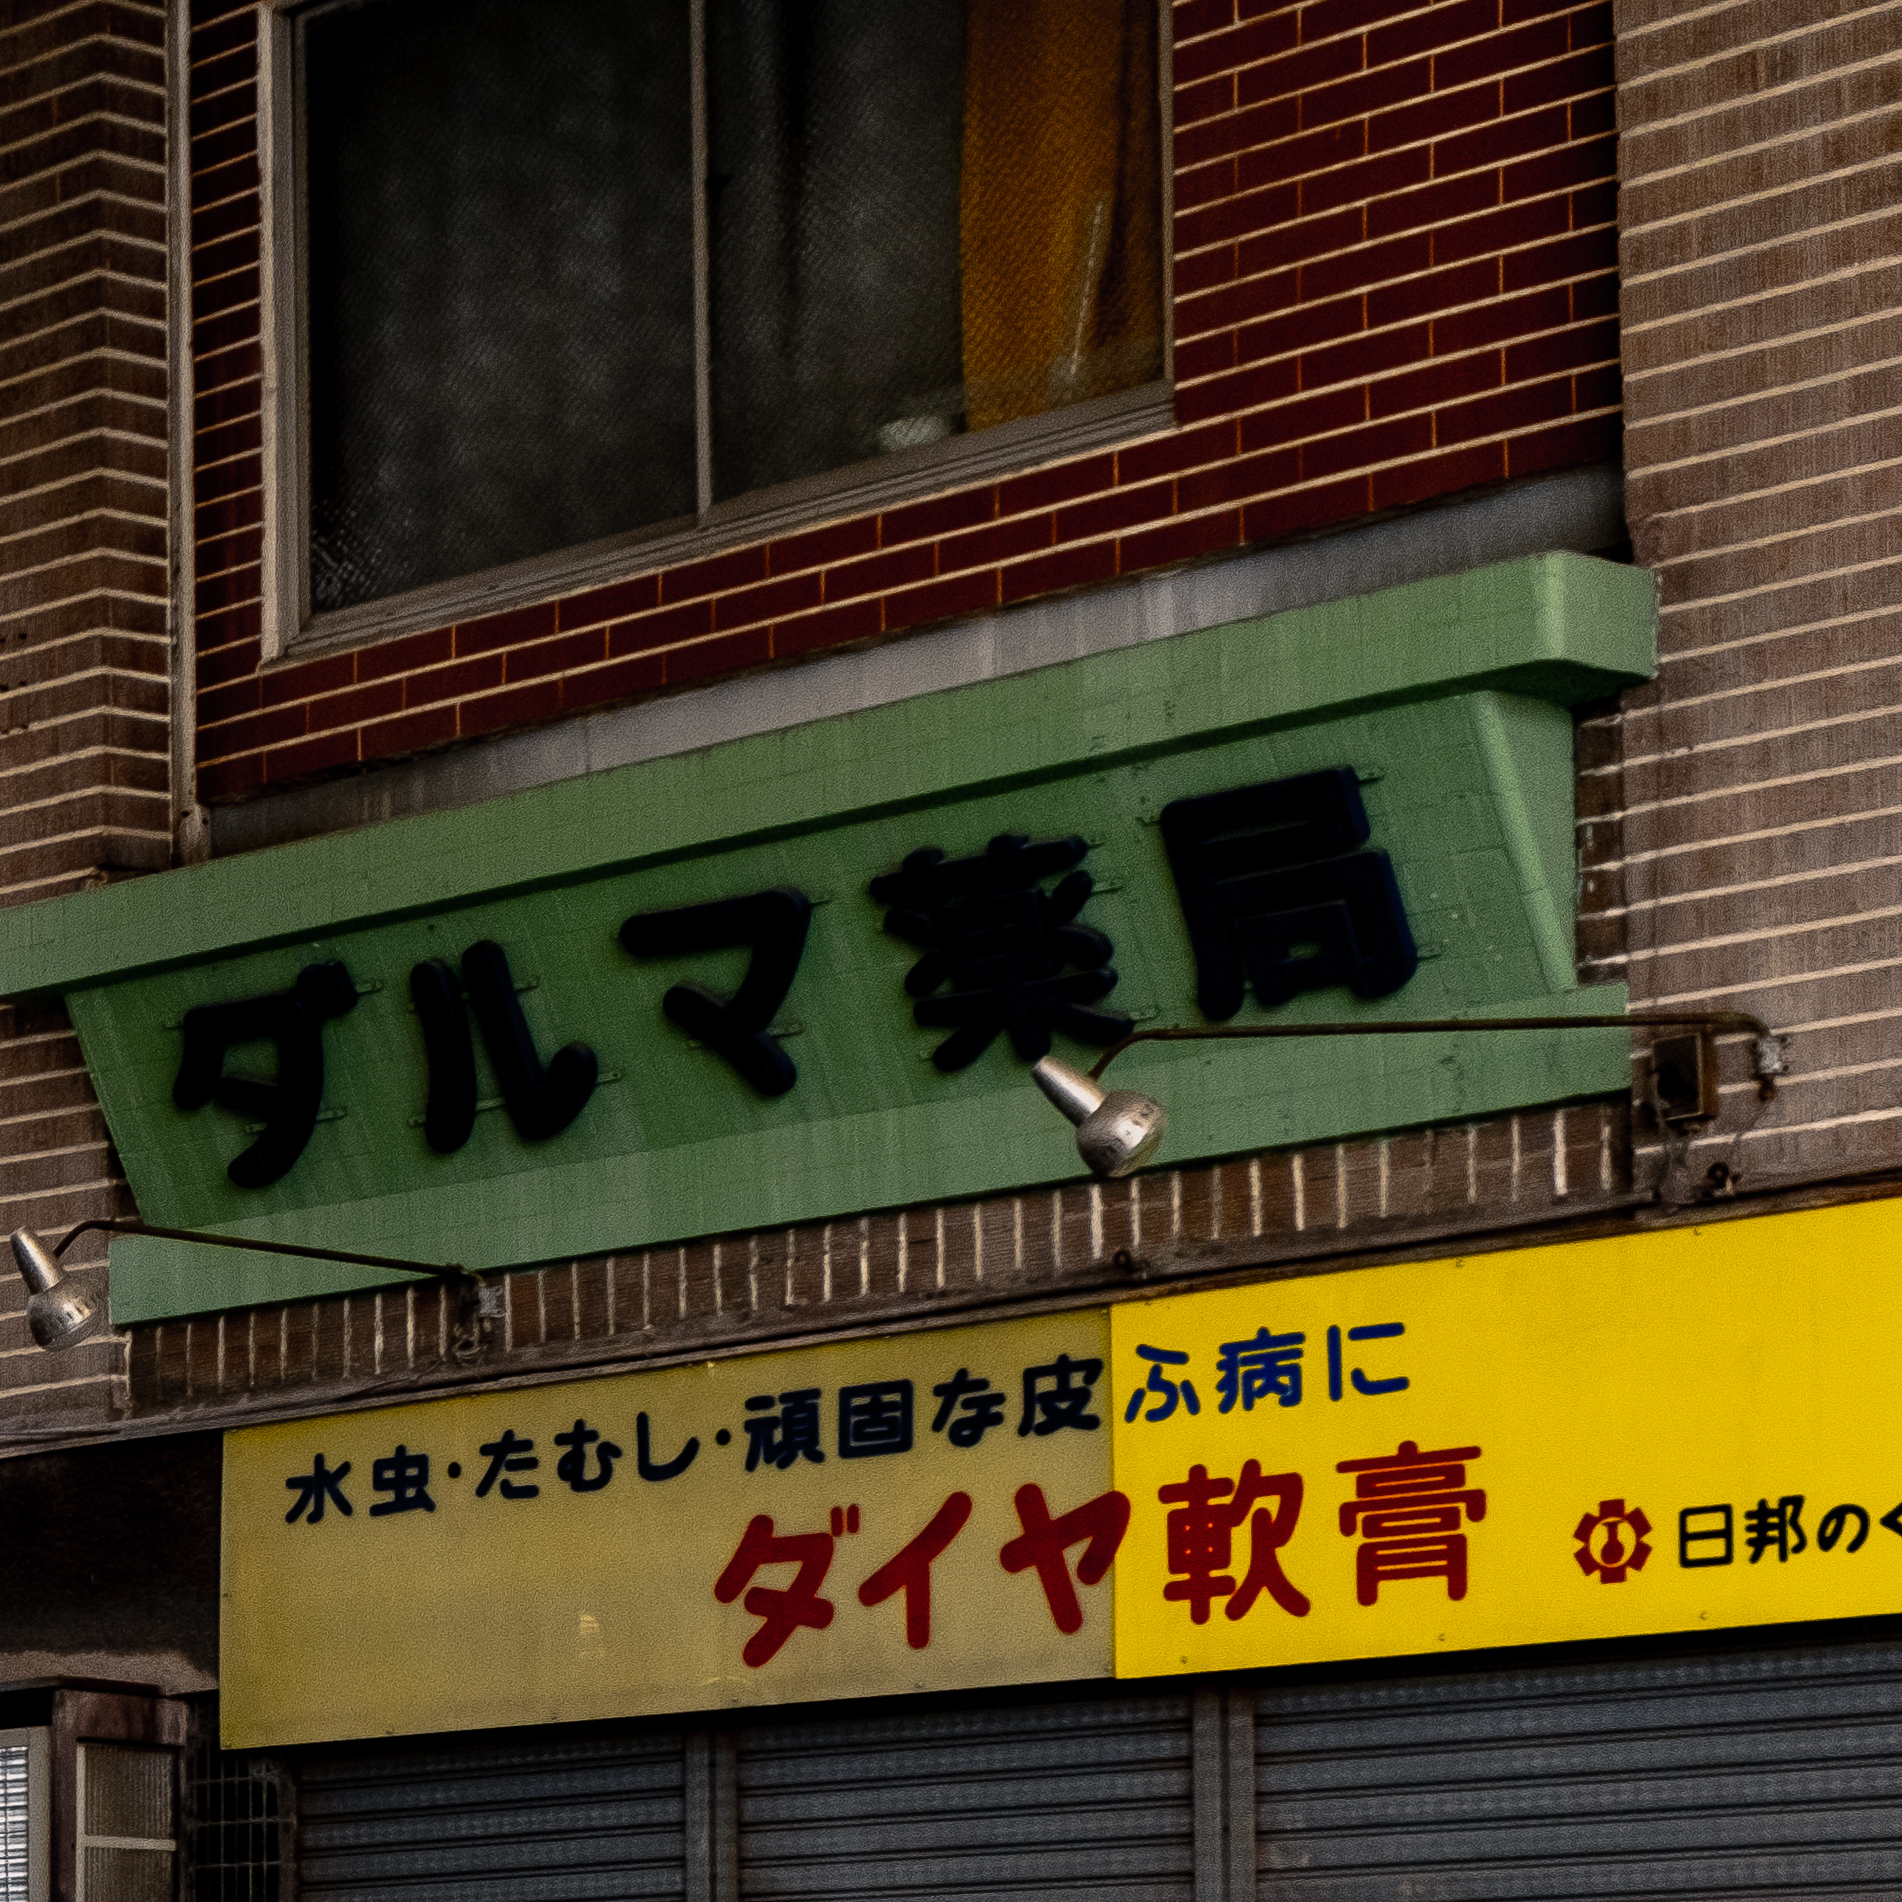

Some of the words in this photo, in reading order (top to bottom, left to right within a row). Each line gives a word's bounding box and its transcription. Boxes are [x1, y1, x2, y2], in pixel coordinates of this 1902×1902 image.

[172, 765, 1419, 1190] ダルマ薬局
[284, 1322, 1411, 1526] 水虫・たむし・頑固な皮ふ病に
[713, 1440, 1487, 1668] ダイヤ軟膏
